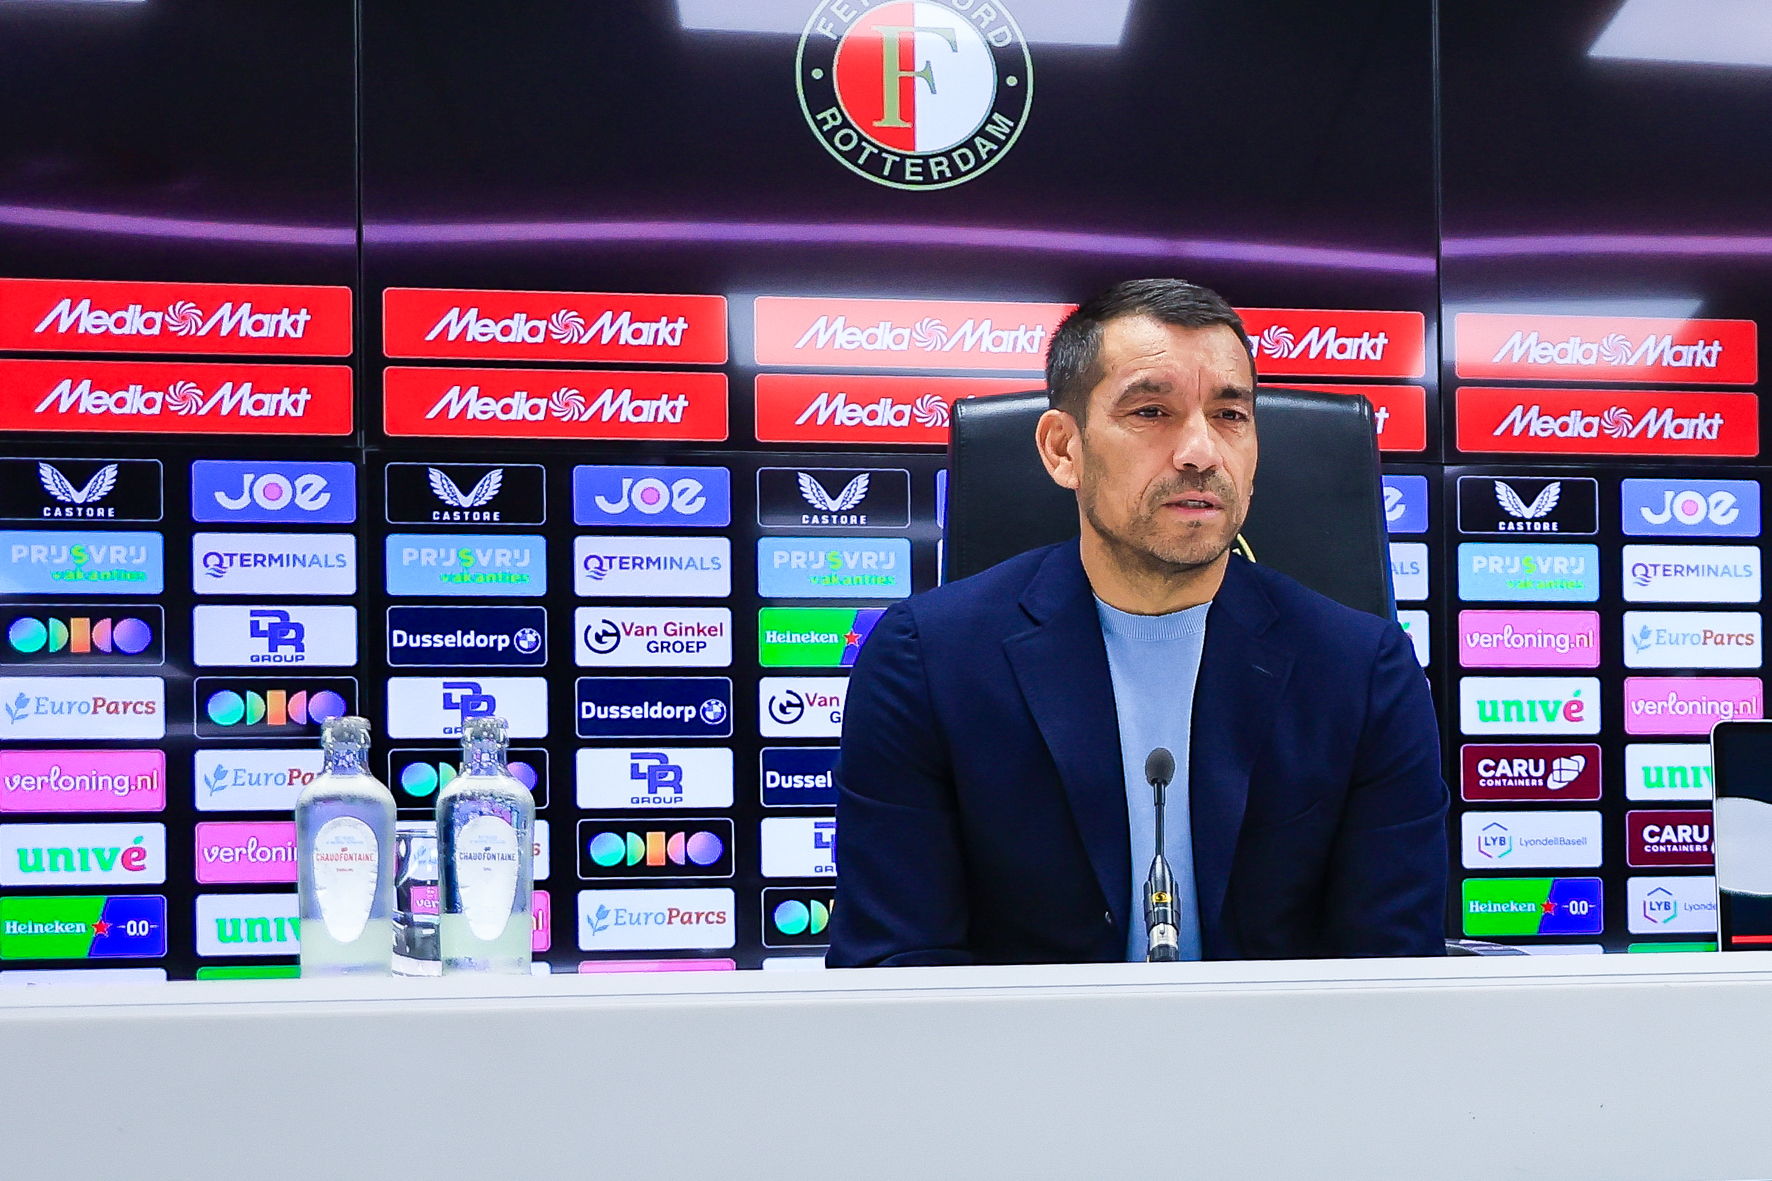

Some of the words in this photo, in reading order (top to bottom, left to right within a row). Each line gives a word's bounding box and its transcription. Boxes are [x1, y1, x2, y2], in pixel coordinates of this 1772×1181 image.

[815, 107, 1014, 181] ROTTERDAM
[35, 298, 163, 335] Media
[201, 302, 310, 338] Markt
[425, 307, 547, 343] Media
[580, 311, 688, 346] Markt
[795, 316, 911, 351] Media
[942, 319, 1046, 354] Markt
[1289, 327, 1388, 361] Markt
[1492, 331, 1599, 365] Media
[1627, 335, 1723, 368] Markt
[35, 379, 163, 415] Media
[201, 381, 311, 417] Markt
[425, 386, 547, 421] Media
[580, 389, 688, 423] Markt
[795, 393, 911, 427] Media
[1493, 405, 1599, 439] Media
[1628, 408, 1724, 440] Markt
[43, 507, 115, 517] CASTORE
[432, 511, 501, 521] CASTORE
[802, 514, 867, 525] CASTORE
[1499, 521, 1559, 531] CASTORE
[622, 623, 657, 637] Van
[663, 622, 723, 637] Ginkel
[765, 630, 838, 645] Heineken
[1466, 625, 1594, 653] verloning.nl
[1656, 629, 1754, 647] EuroParcs
[393, 630, 509, 655] Dusseldorp
[646, 641, 706, 653] GROEP
[250, 654, 305, 663] GROUP
[35, 697, 156, 716] EuroParcs
[805, 693, 839, 707] Van
[1478, 690, 1583, 723] univé
[1631, 692, 1757, 720] verloning.nl
[582, 702, 696, 722] Dusseldorp
[233, 768, 318, 786] EuroPa
[1478, 759, 1545, 778] CARU
[4, 764, 158, 797] verloning.nl
[766, 772, 832, 788] Dussel
[1480, 779, 1543, 788] CONTAINERS
[1484, 836, 1506, 846] LYB
[1519, 837, 1587, 849] LyondellBasell
[1643, 825, 1708, 843] CARU
[19, 835, 146, 872] univé
[204, 834, 297, 863] verloni
[459, 852, 516, 861] CHAUDFONTAINE
[1469, 900, 1535, 913] Heineken
[1649, 901, 1671, 911] LYB
[614, 907, 726, 926] EuroParcs
[4, 919, 86, 934] Heineken
